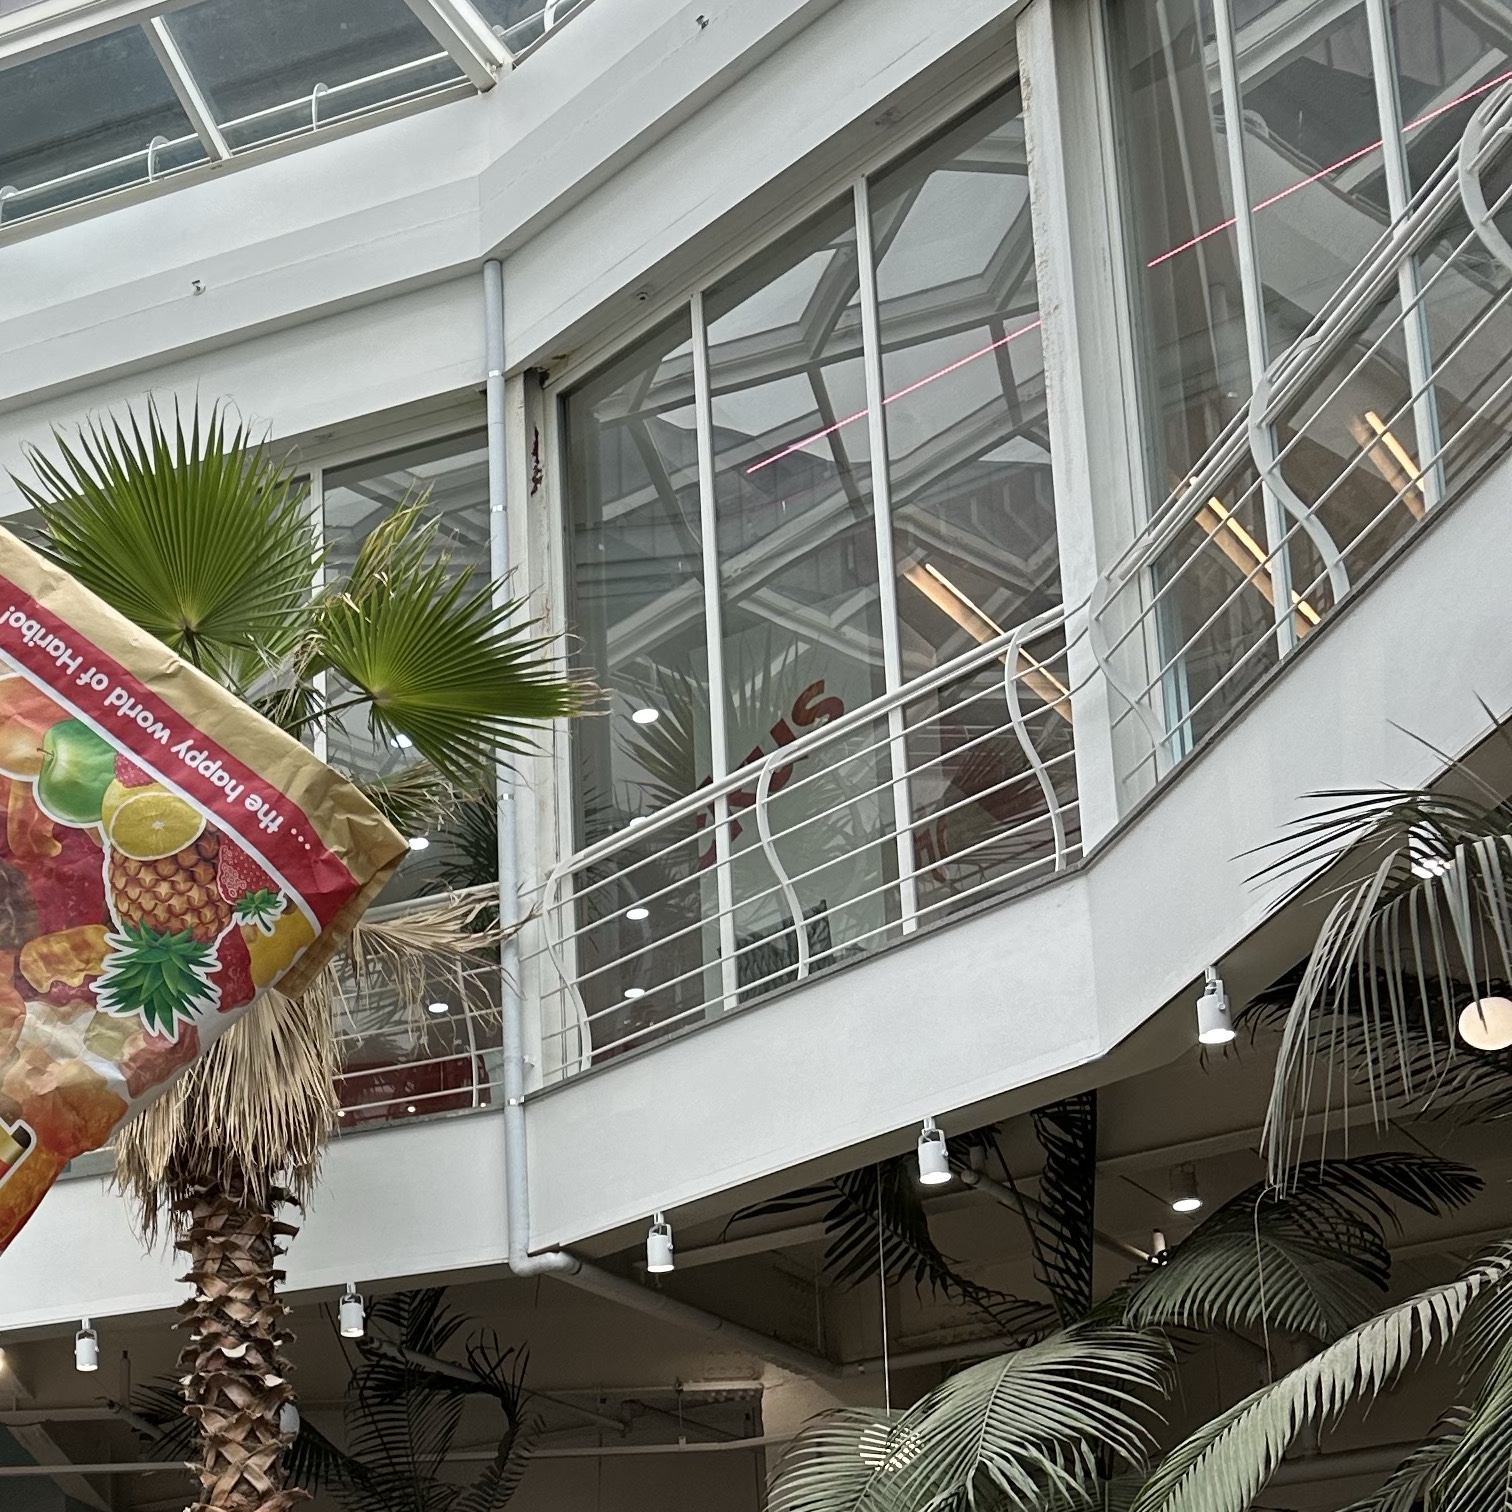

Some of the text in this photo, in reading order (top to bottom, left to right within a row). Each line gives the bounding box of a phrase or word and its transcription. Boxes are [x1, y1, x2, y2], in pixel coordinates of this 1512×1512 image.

[75, 666, 111, 692] of
[104, 688, 172, 745] world
[170, 738, 244, 803] happy
[244, 793, 284, 834] the
